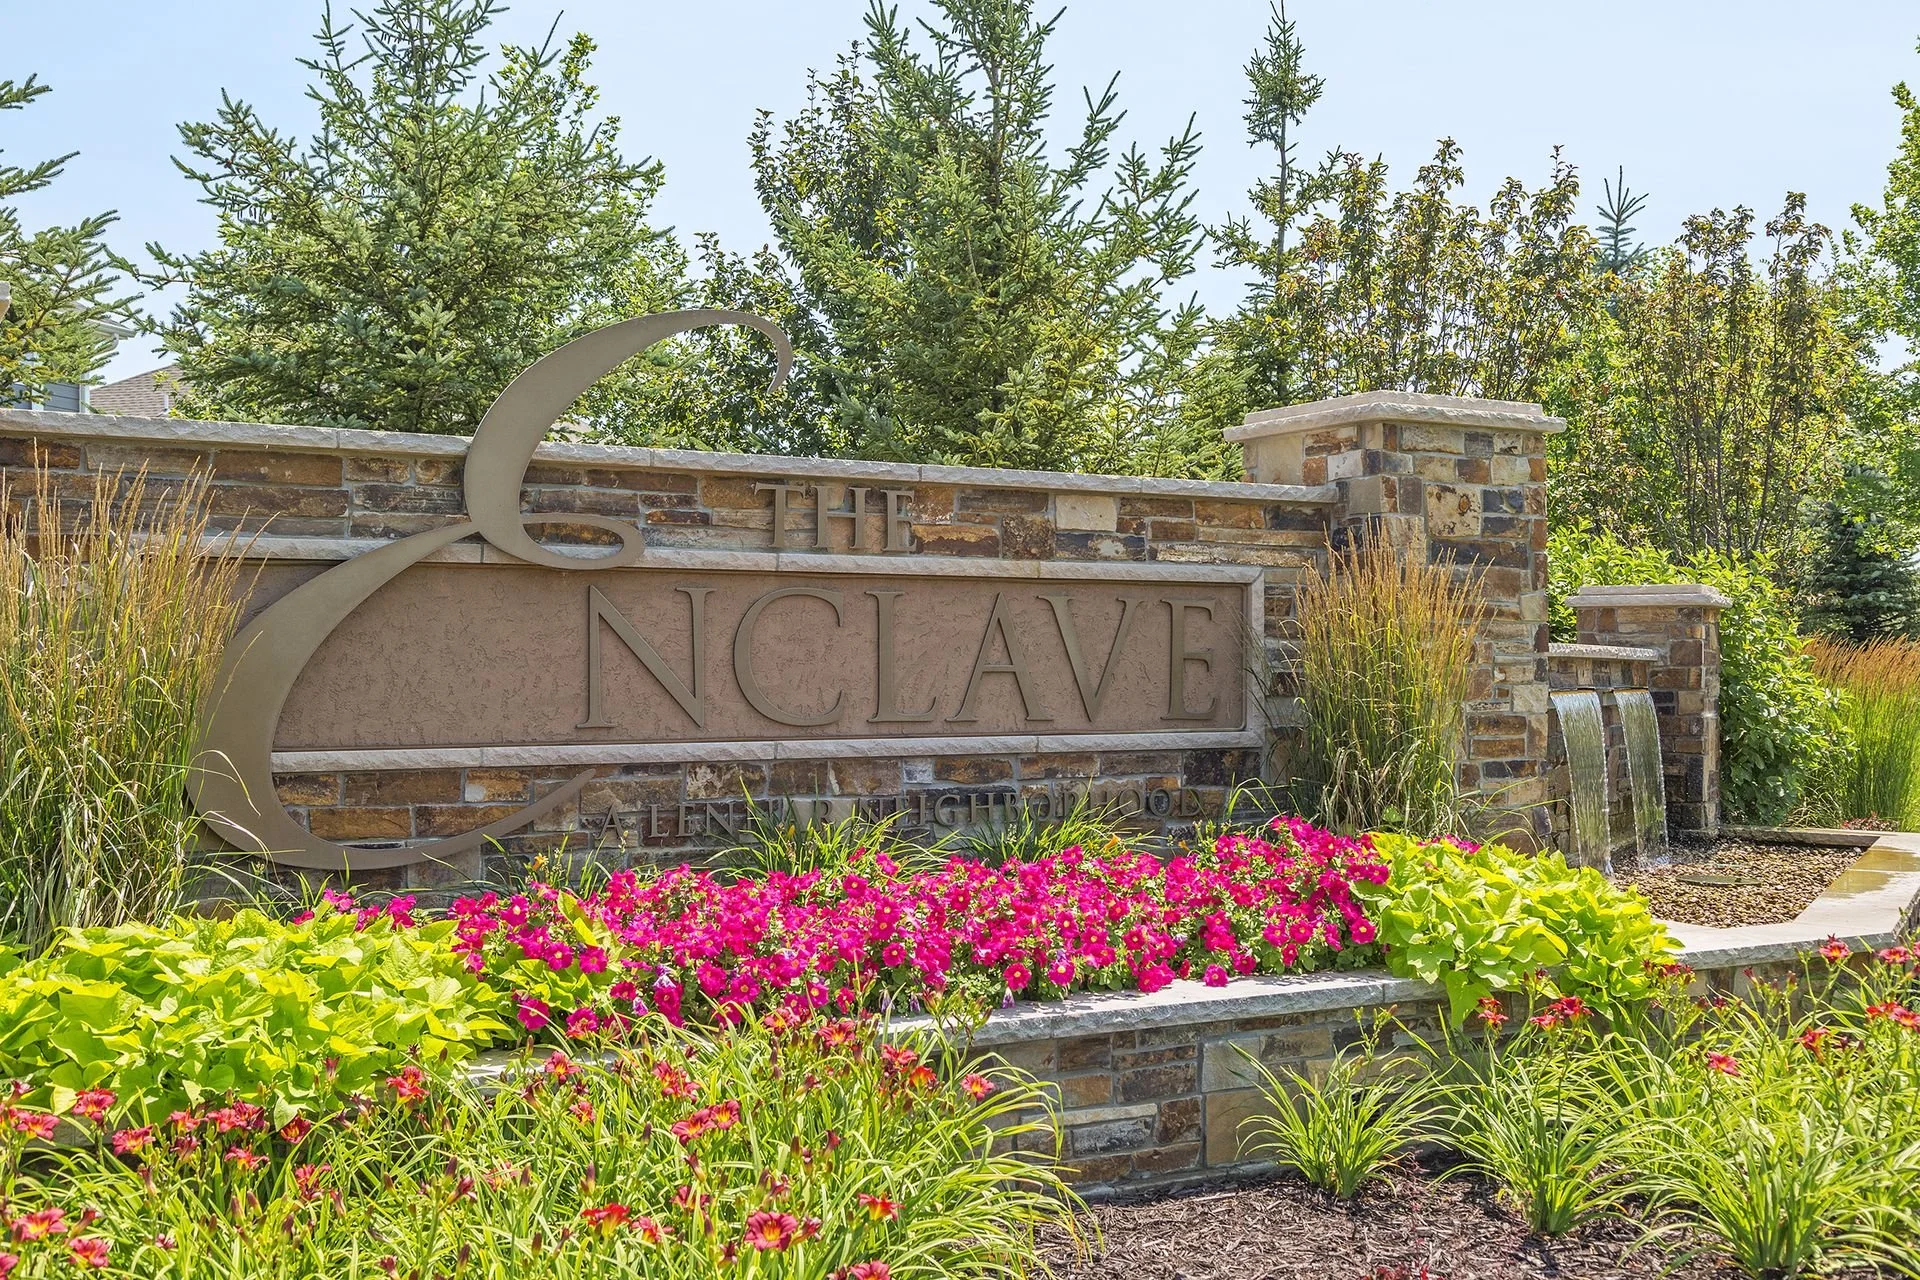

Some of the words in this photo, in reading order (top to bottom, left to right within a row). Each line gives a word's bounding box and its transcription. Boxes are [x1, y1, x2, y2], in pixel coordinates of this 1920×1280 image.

[754, 482, 917, 551] THE
[185, 308, 1218, 871] ENCLAVE
[596, 802, 626, 840] A
